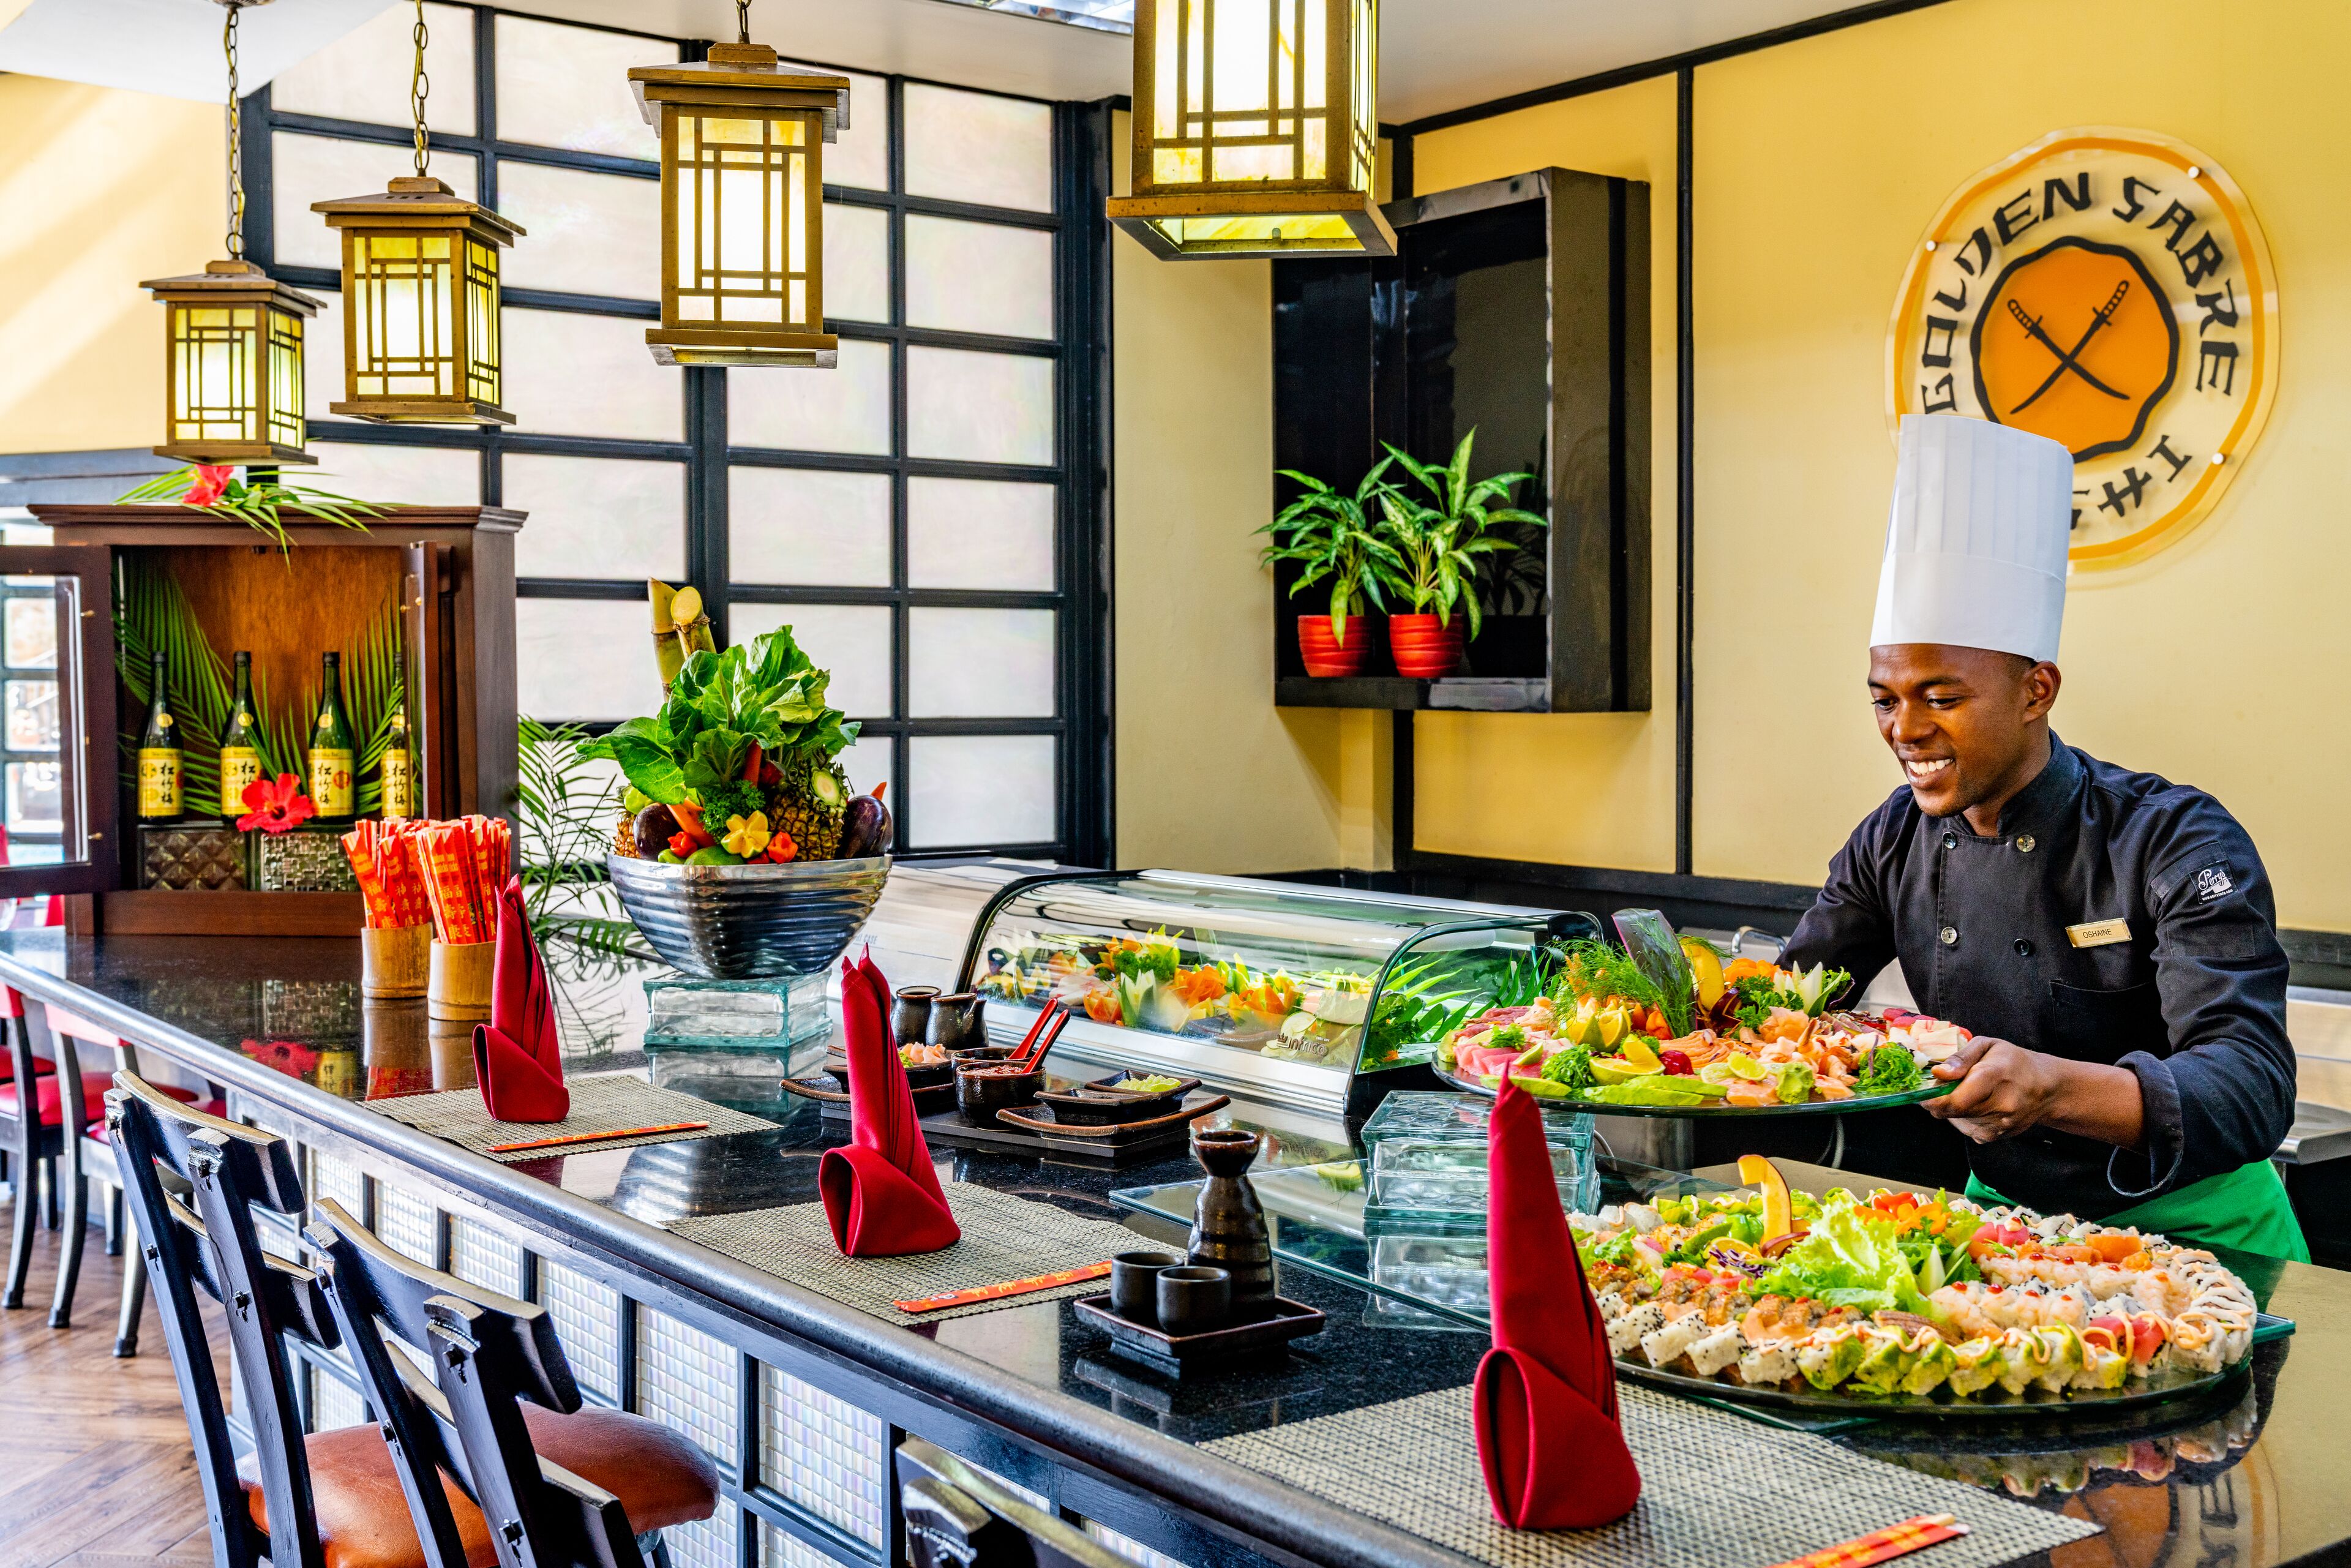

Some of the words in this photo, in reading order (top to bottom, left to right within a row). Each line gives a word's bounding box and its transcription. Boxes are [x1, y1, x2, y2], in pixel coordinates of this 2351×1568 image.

[1921, 172, 2090, 414] GOLDEN
[2112, 176, 2239, 396] SABRE
[2083, 928, 2112, 939] OSHAINE
